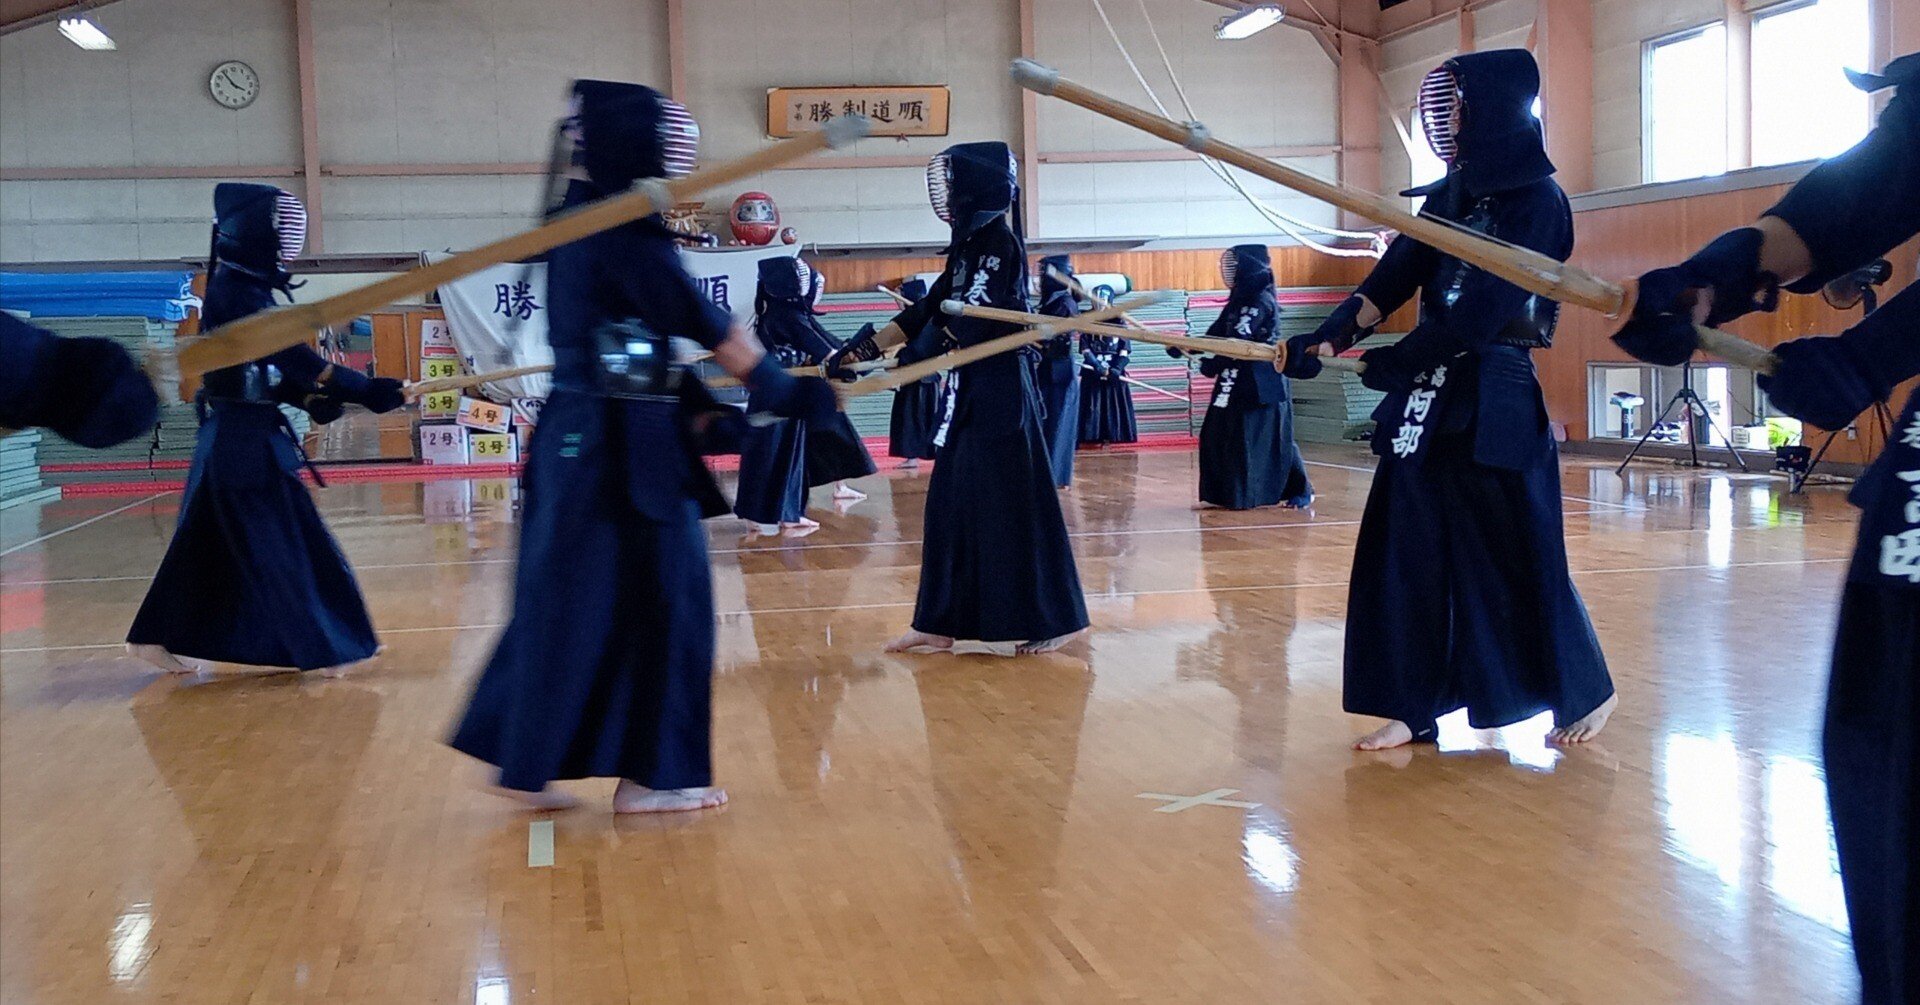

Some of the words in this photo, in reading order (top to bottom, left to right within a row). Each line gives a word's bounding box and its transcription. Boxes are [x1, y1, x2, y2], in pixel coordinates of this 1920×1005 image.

[493, 280, 545, 320] 勝
[429, 364, 455, 377] 3号
[429, 396, 453, 409] 3号
[471, 407, 498, 422] 4号
[1391, 388, 1436, 459] 阿部
[429, 432, 453, 446] 2号
[478, 440, 503, 454] 3号
